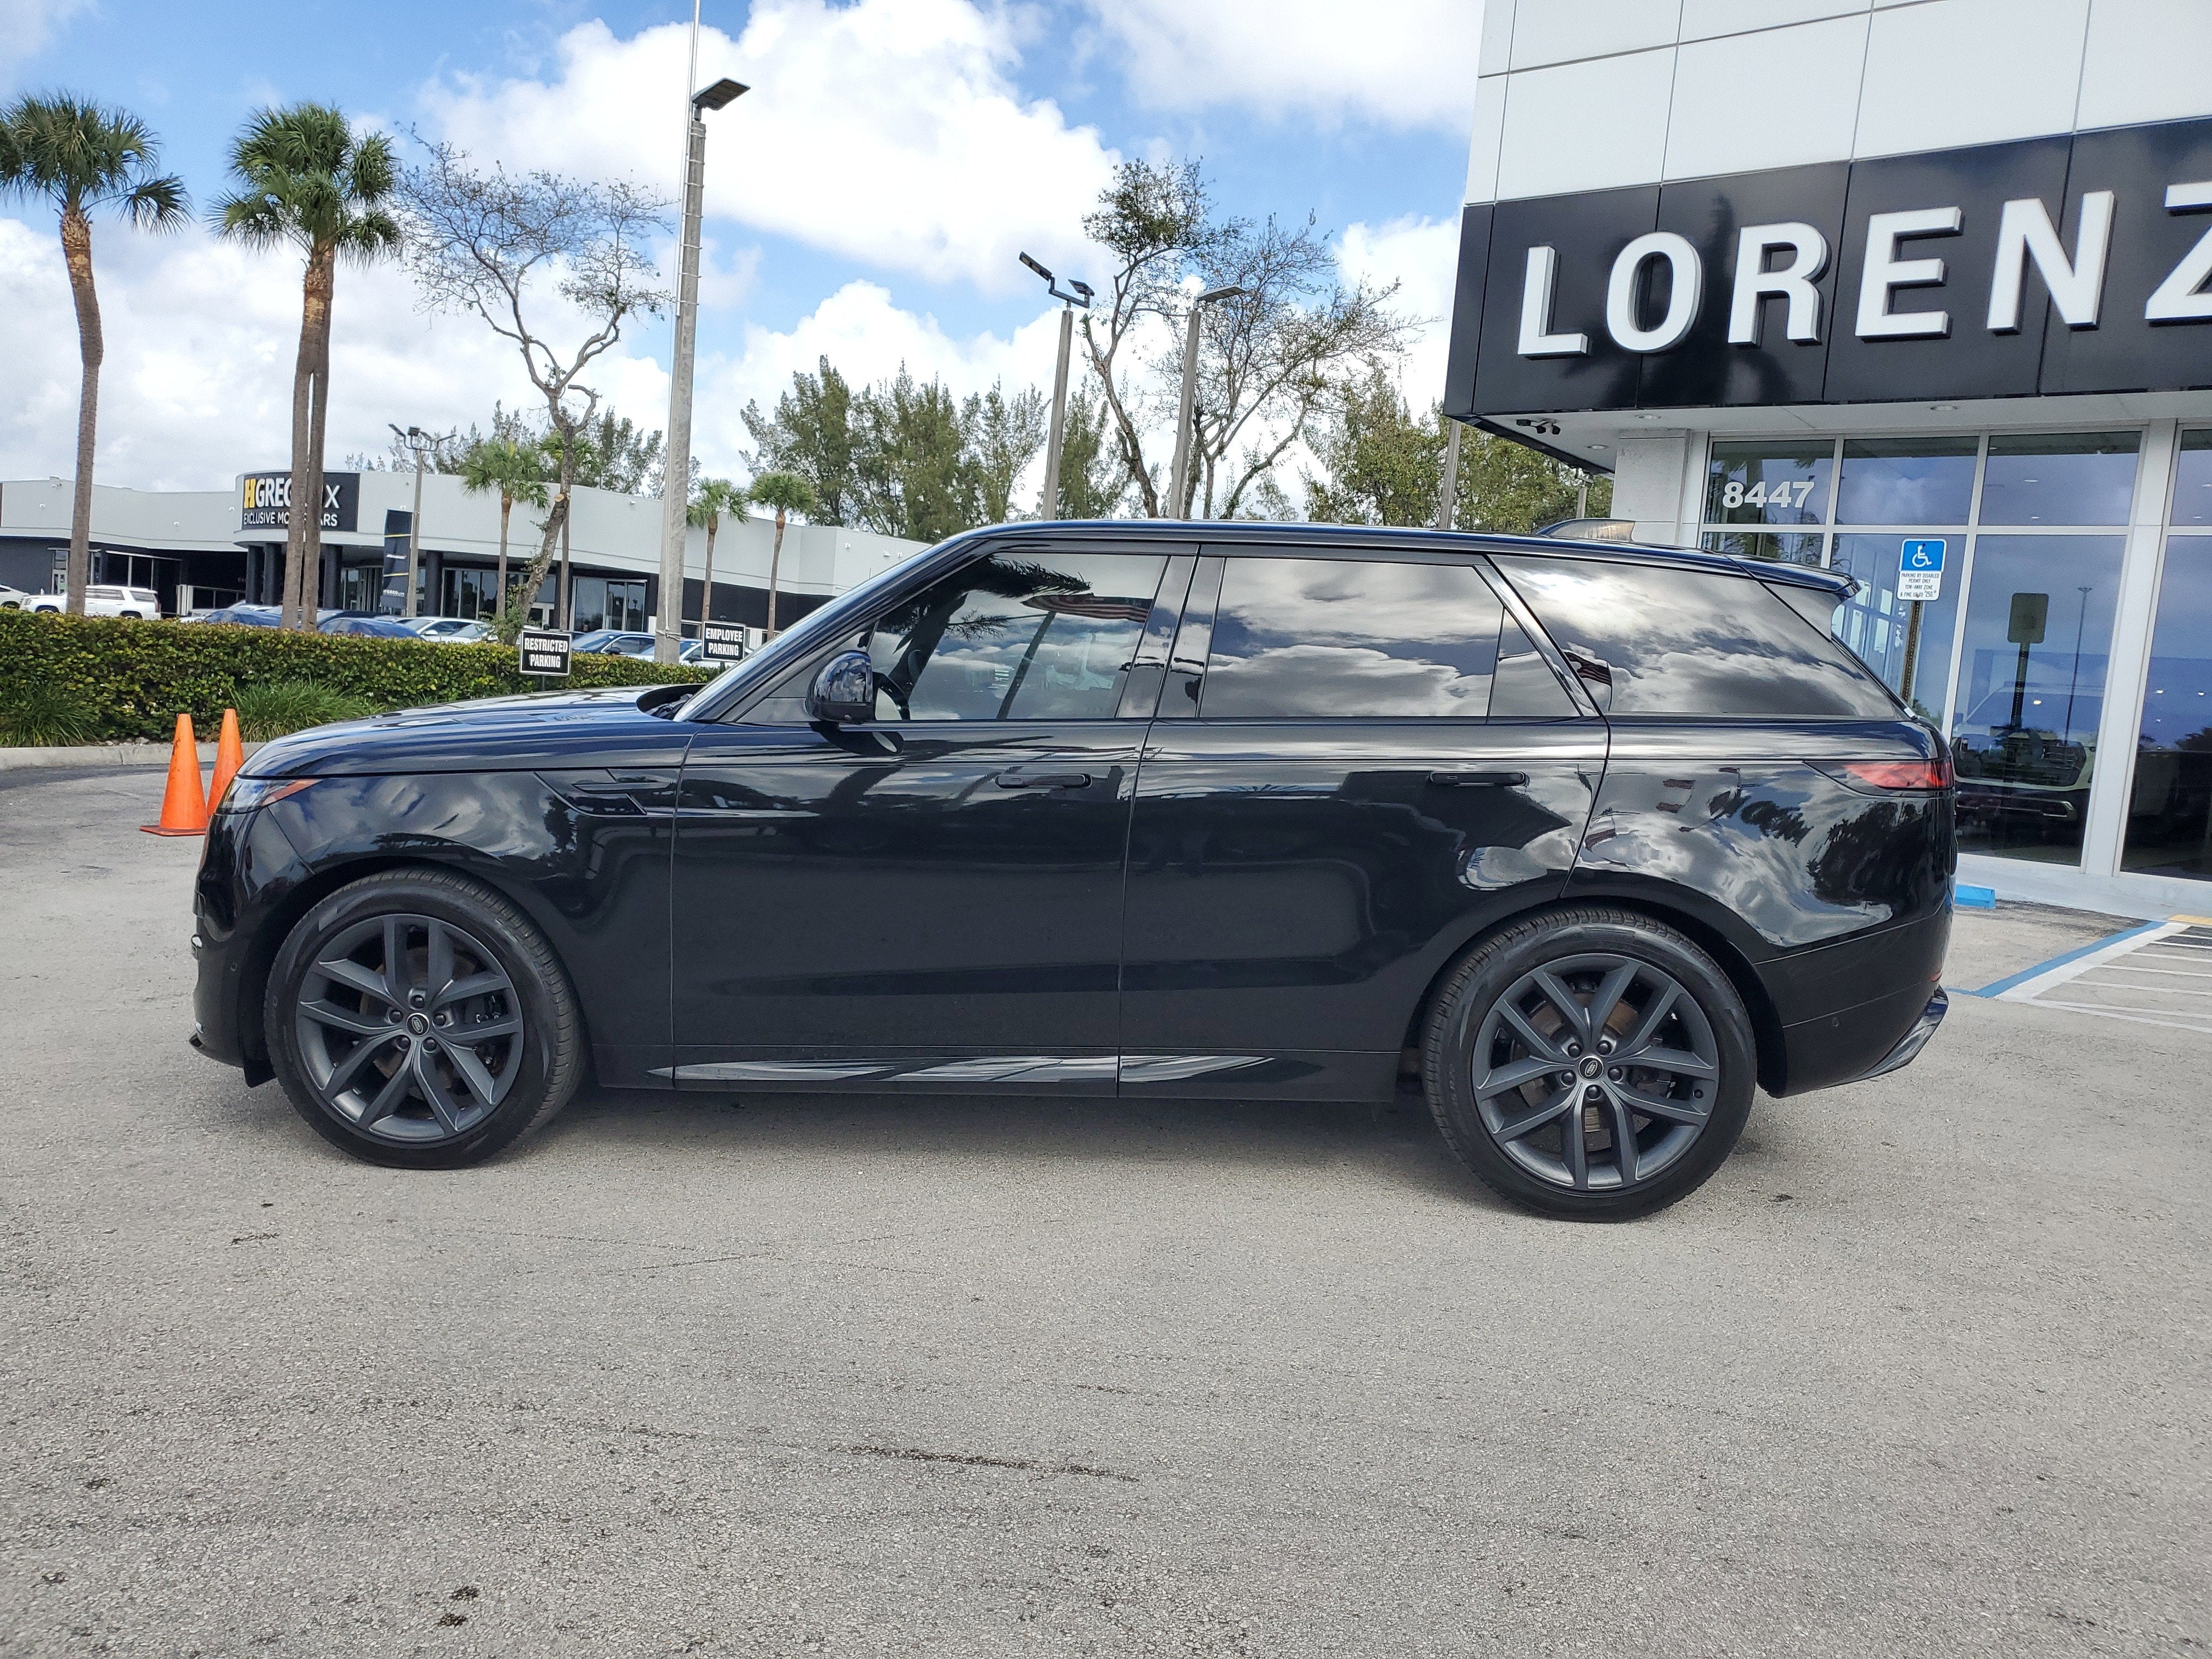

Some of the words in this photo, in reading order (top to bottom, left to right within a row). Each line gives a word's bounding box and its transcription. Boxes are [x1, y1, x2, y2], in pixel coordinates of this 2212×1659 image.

[1517, 182, 2212, 358] LORENZ
[244, 477, 340, 509] HGREGX
[1722, 481, 1814, 508] 8447
[244, 511, 275, 526] EXCLUSIVE
[706, 628, 743, 642] EMPLOYEE
[524, 637, 568, 653] RESTRICTED
[708, 642, 739, 656] PARKING
[529, 654, 561, 668] PARKING
